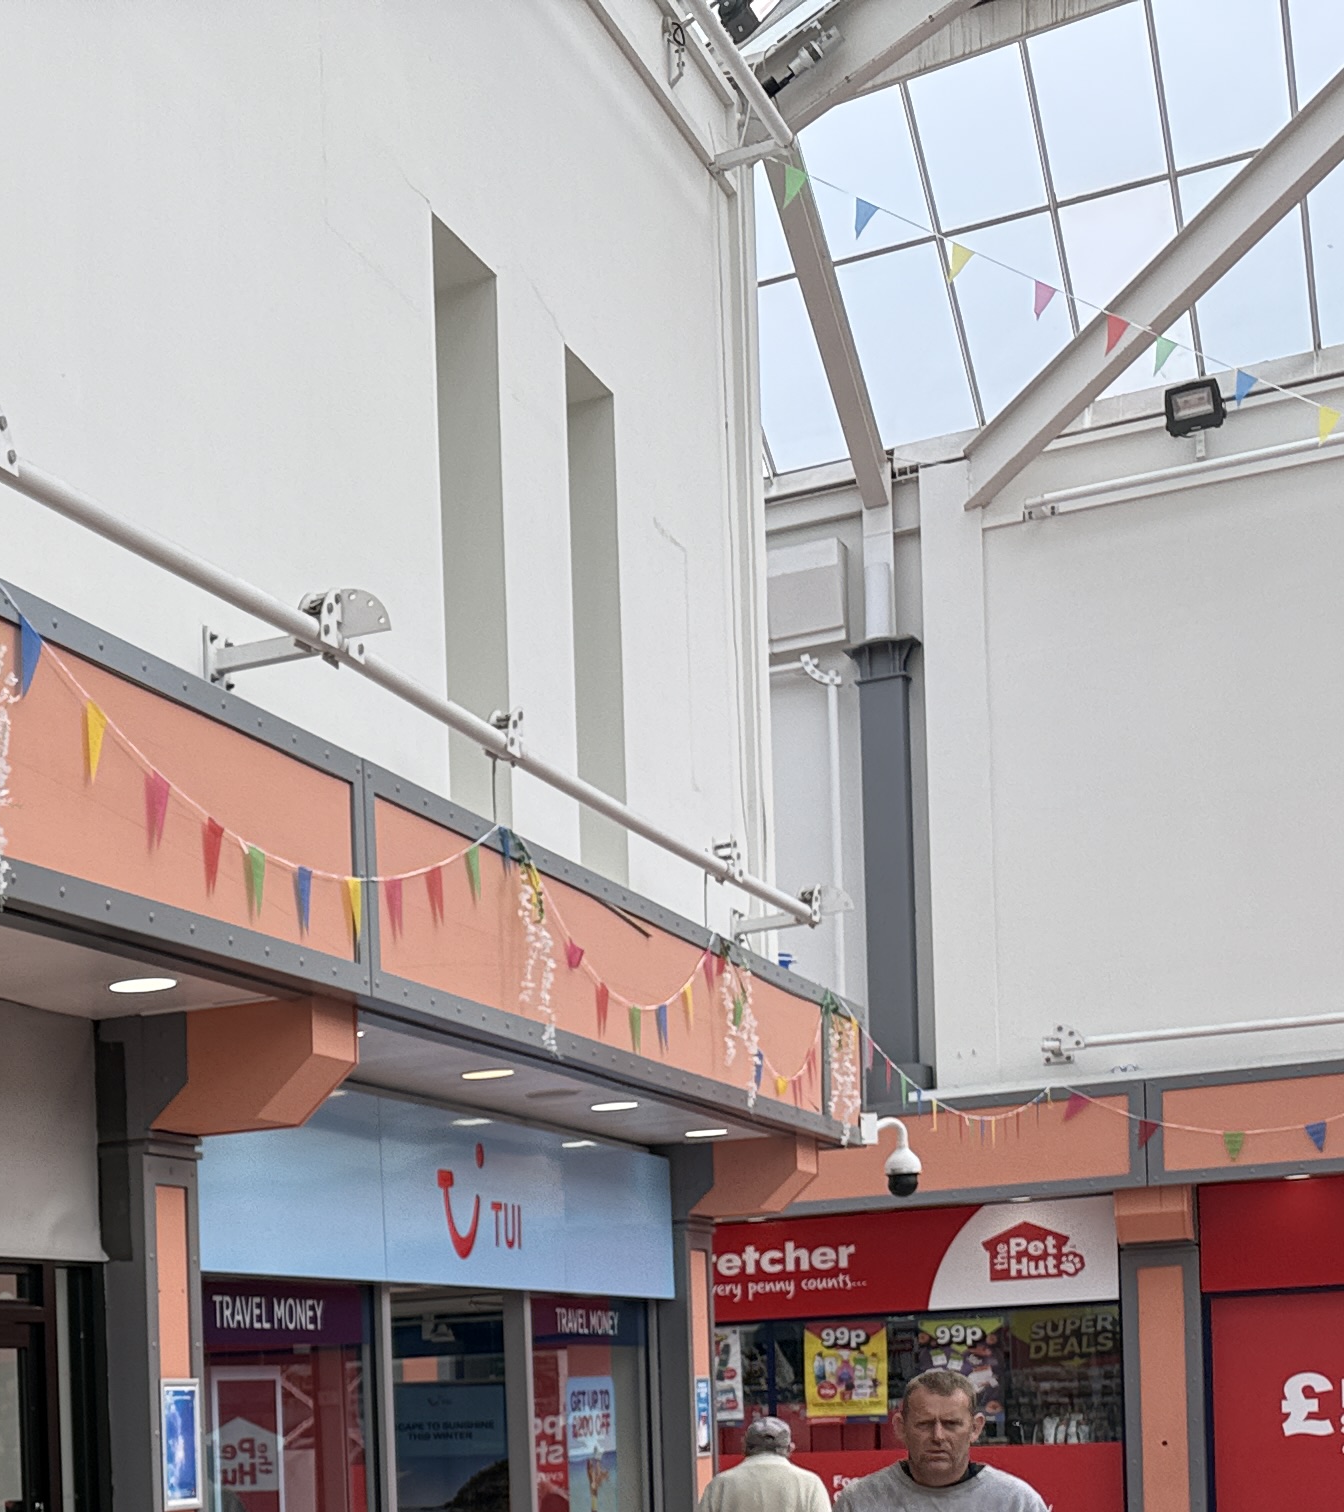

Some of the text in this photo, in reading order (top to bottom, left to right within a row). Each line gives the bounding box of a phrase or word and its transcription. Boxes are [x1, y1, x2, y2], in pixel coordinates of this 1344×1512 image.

[491, 1201, 522, 1250] TUI
[1010, 1256, 1058, 1277] Hut
[748, 1278, 795, 1301] penny
[212, 1294, 324, 1331] TRAVEL MONEY
[555, 1306, 620, 1336] TRAVEL MONEY
[820, 1326, 867, 1349] 99p
[935, 1324, 983, 1346] 99p
[1031, 1313, 1113, 1340] SUPER
[1029, 1332, 1114, 1360] DEALS
